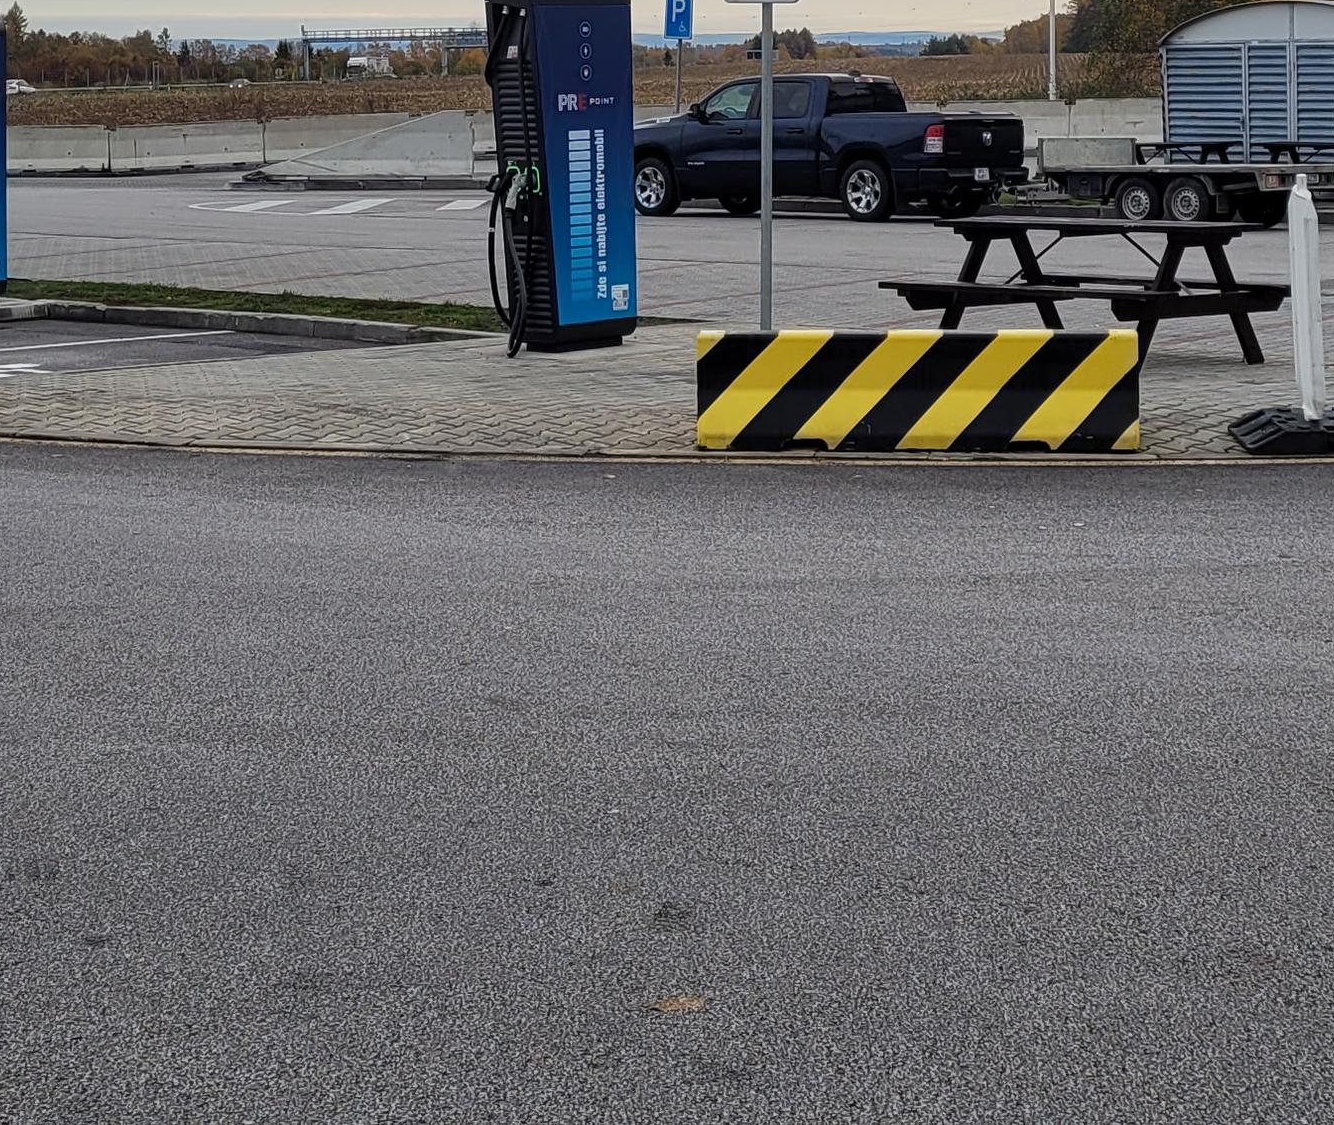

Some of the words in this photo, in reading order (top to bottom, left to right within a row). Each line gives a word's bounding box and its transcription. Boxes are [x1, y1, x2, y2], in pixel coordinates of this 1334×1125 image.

[557, 92, 587, 112] PRE
[589, 97, 615, 105] POINT
[594, 129, 607, 210] elektromobil
[595, 214, 607, 257] nabijte
[597, 261, 607, 272] si
[597, 276, 608, 299] Zde
